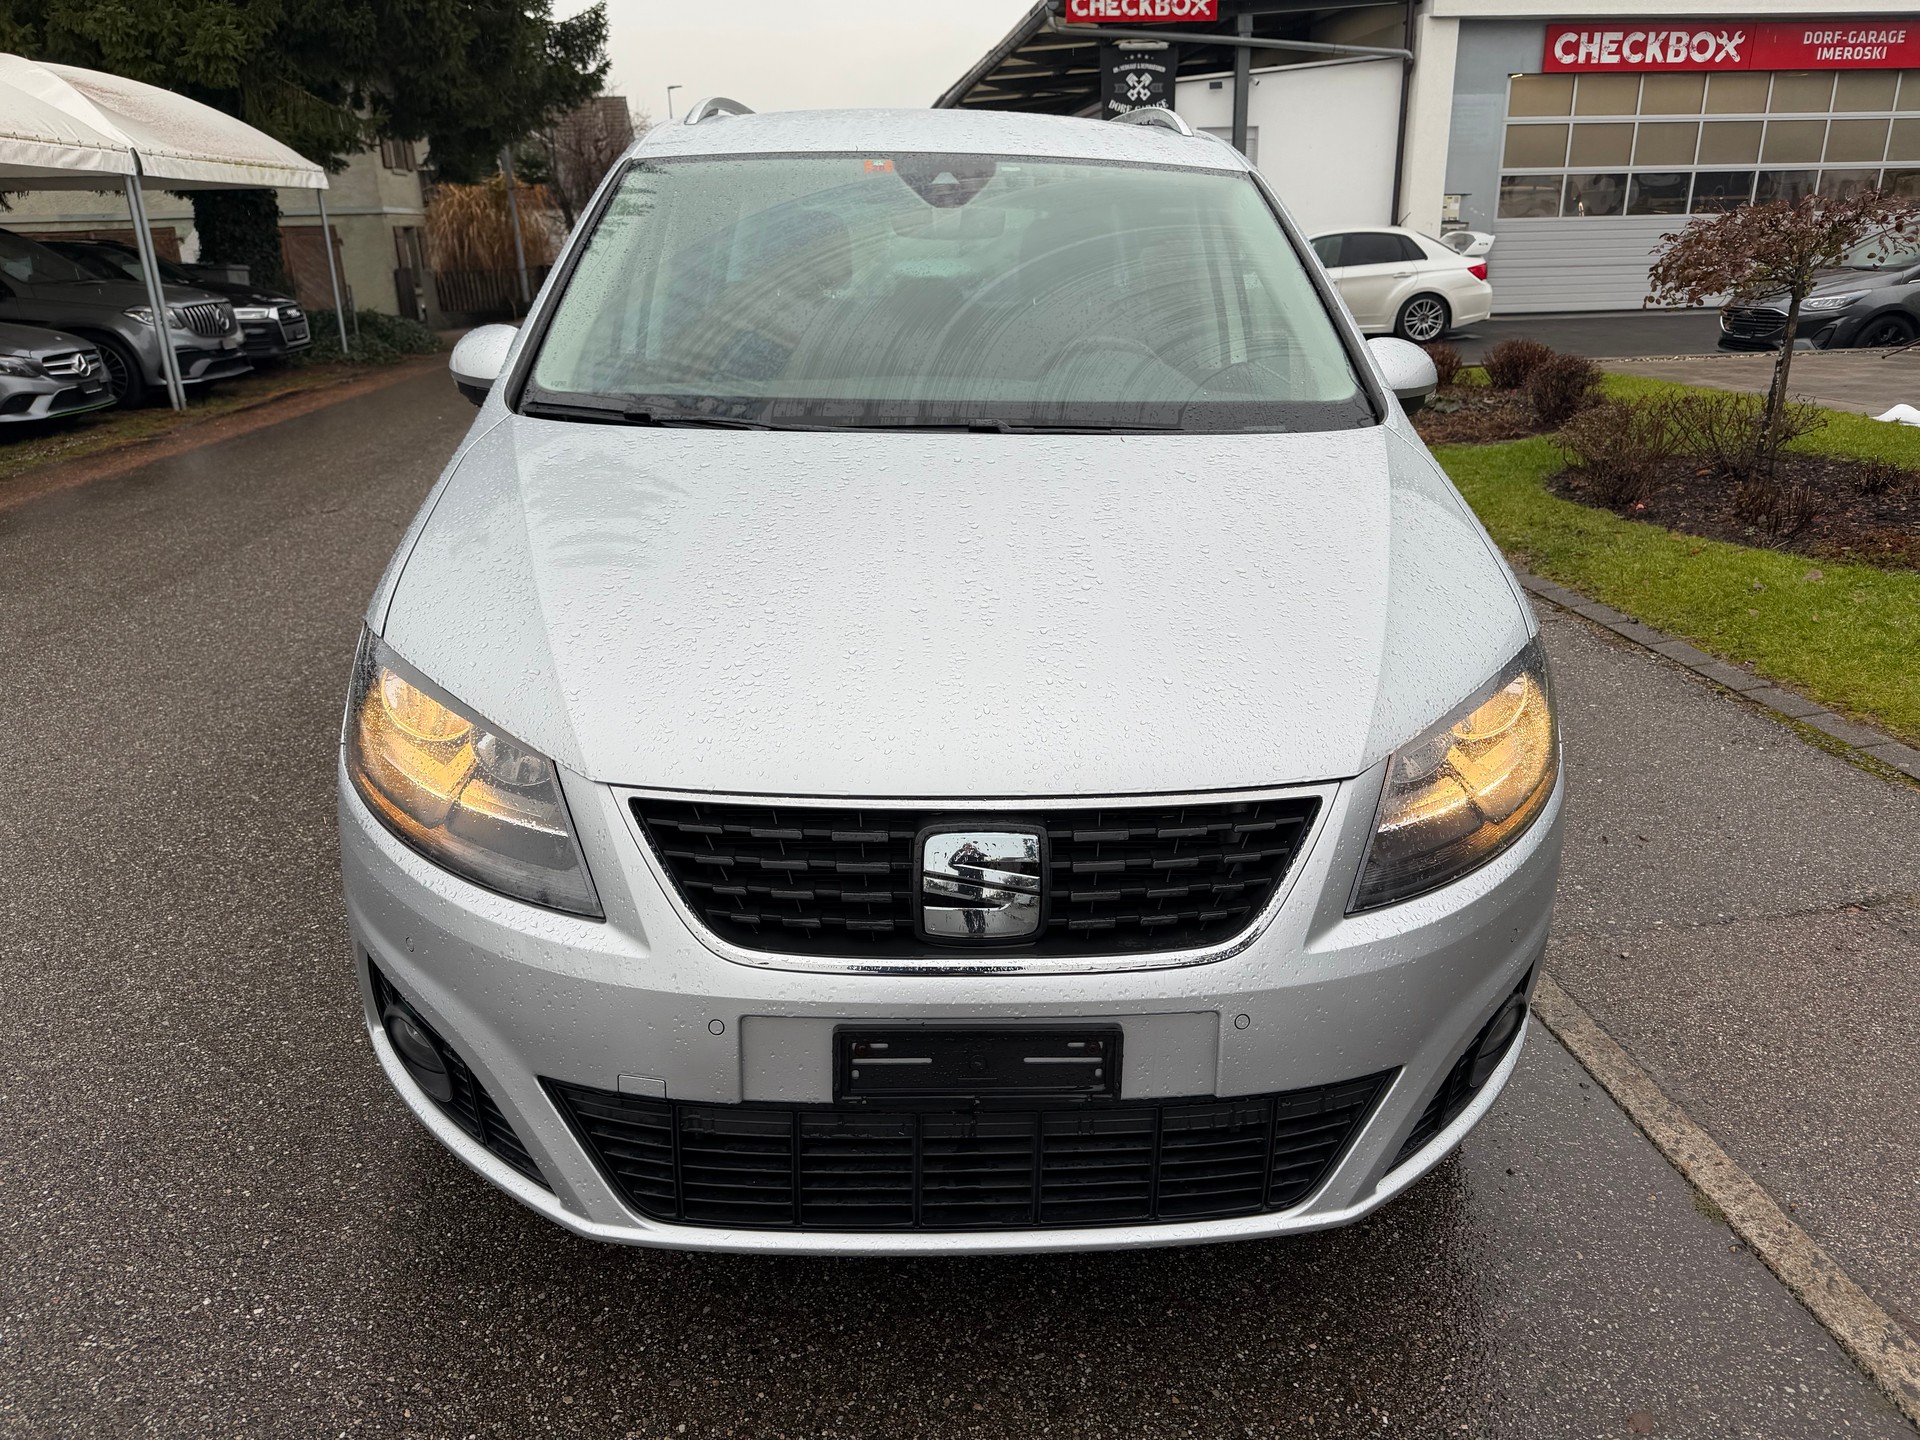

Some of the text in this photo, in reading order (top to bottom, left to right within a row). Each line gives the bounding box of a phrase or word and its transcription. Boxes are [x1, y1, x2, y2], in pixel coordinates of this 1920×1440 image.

[1071, 0, 1211, 17] CHECKBOX
[1803, 30, 1907, 45] DORF-GARAGE
[1554, 31, 1746, 65] CHECKBOX
[1816, 46, 1888, 60] IMEROSKI
